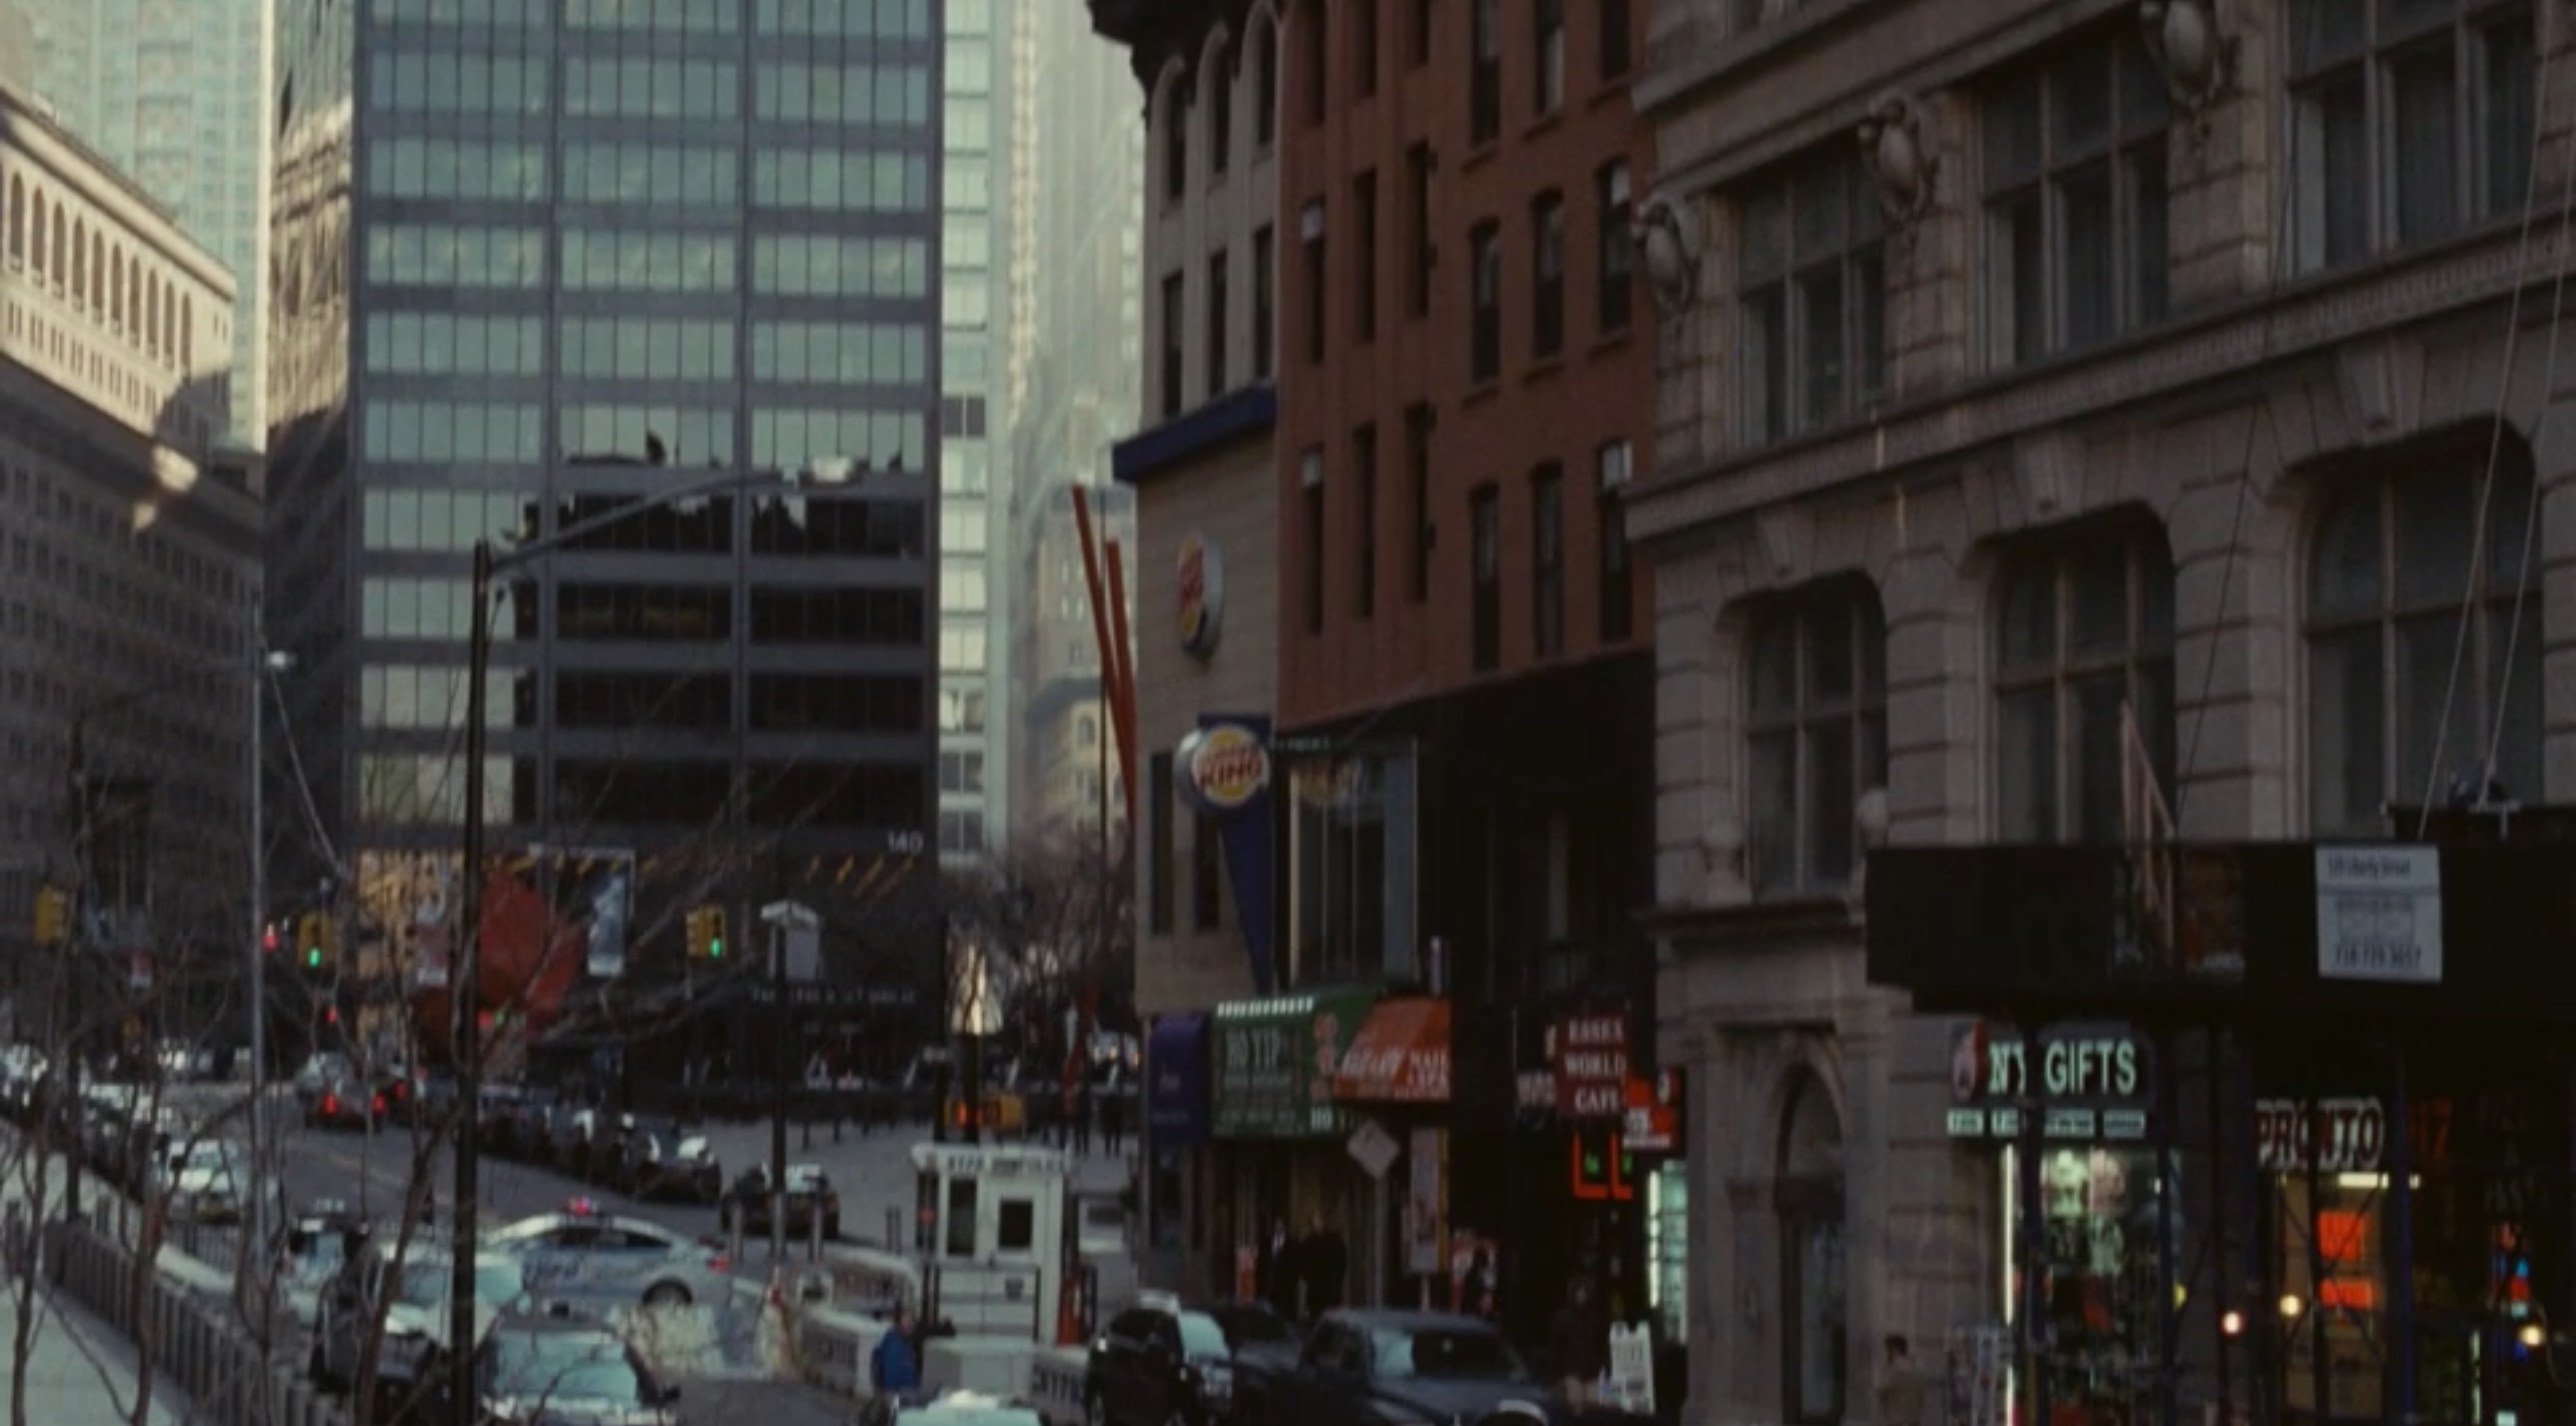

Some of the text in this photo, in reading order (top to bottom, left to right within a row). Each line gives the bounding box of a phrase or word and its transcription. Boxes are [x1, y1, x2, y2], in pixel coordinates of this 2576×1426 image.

[1199, 758, 1262, 788] KING
[887, 828, 925, 854] 140
[1564, 1052, 1628, 1079] WORLD
[2044, 1038, 2138, 1095] GIFTS
